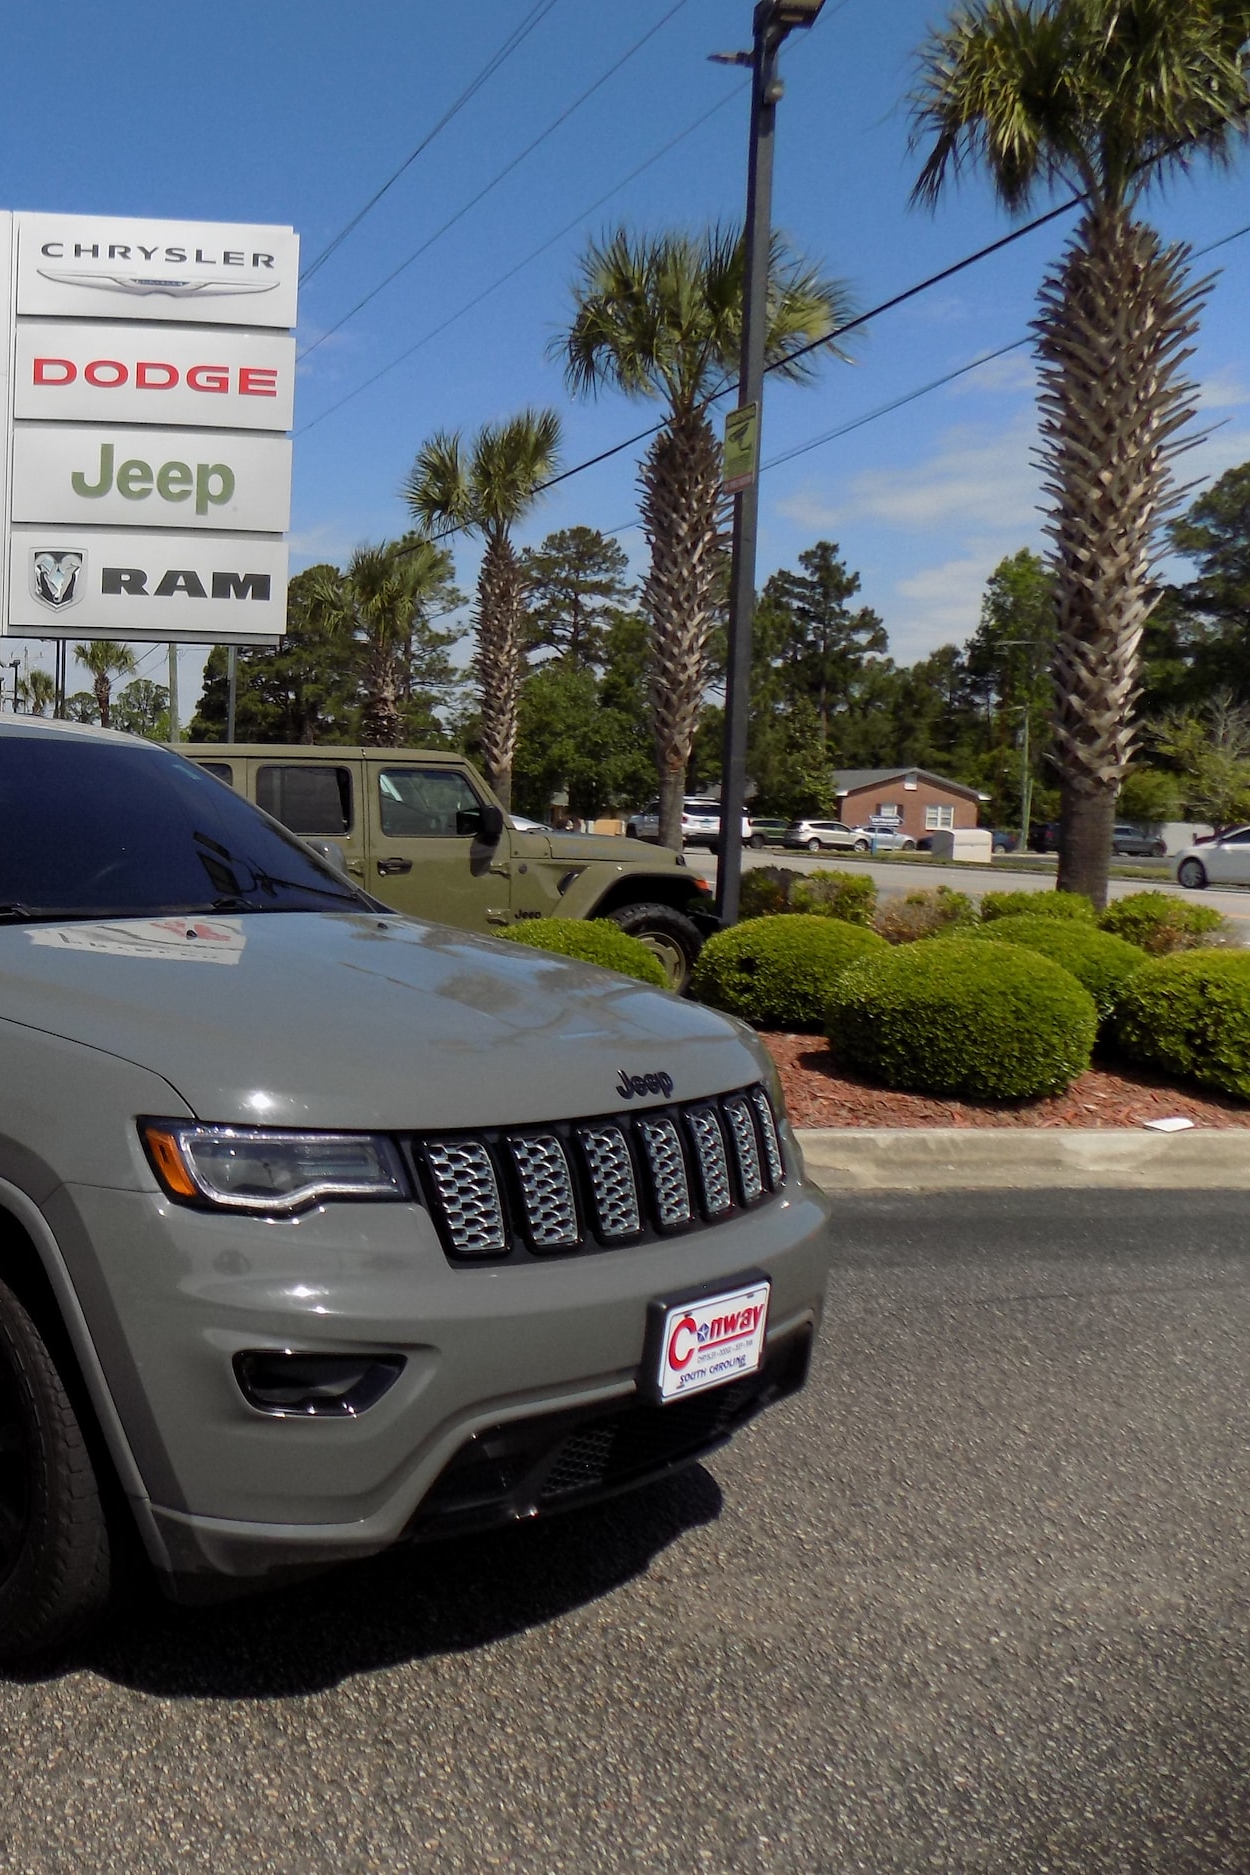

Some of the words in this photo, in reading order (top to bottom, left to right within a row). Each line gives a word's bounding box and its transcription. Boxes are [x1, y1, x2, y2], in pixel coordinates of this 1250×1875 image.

[40, 242, 276, 269] CHRYSLER
[33, 357, 278, 398] DODGE
[70, 443, 236, 516] Jeep
[101, 567, 272, 601] RAM
[615, 1069, 674, 1100] Jeep
[668, 1304, 765, 1371] Conway
[679, 1367, 707, 1385] SOUTH
